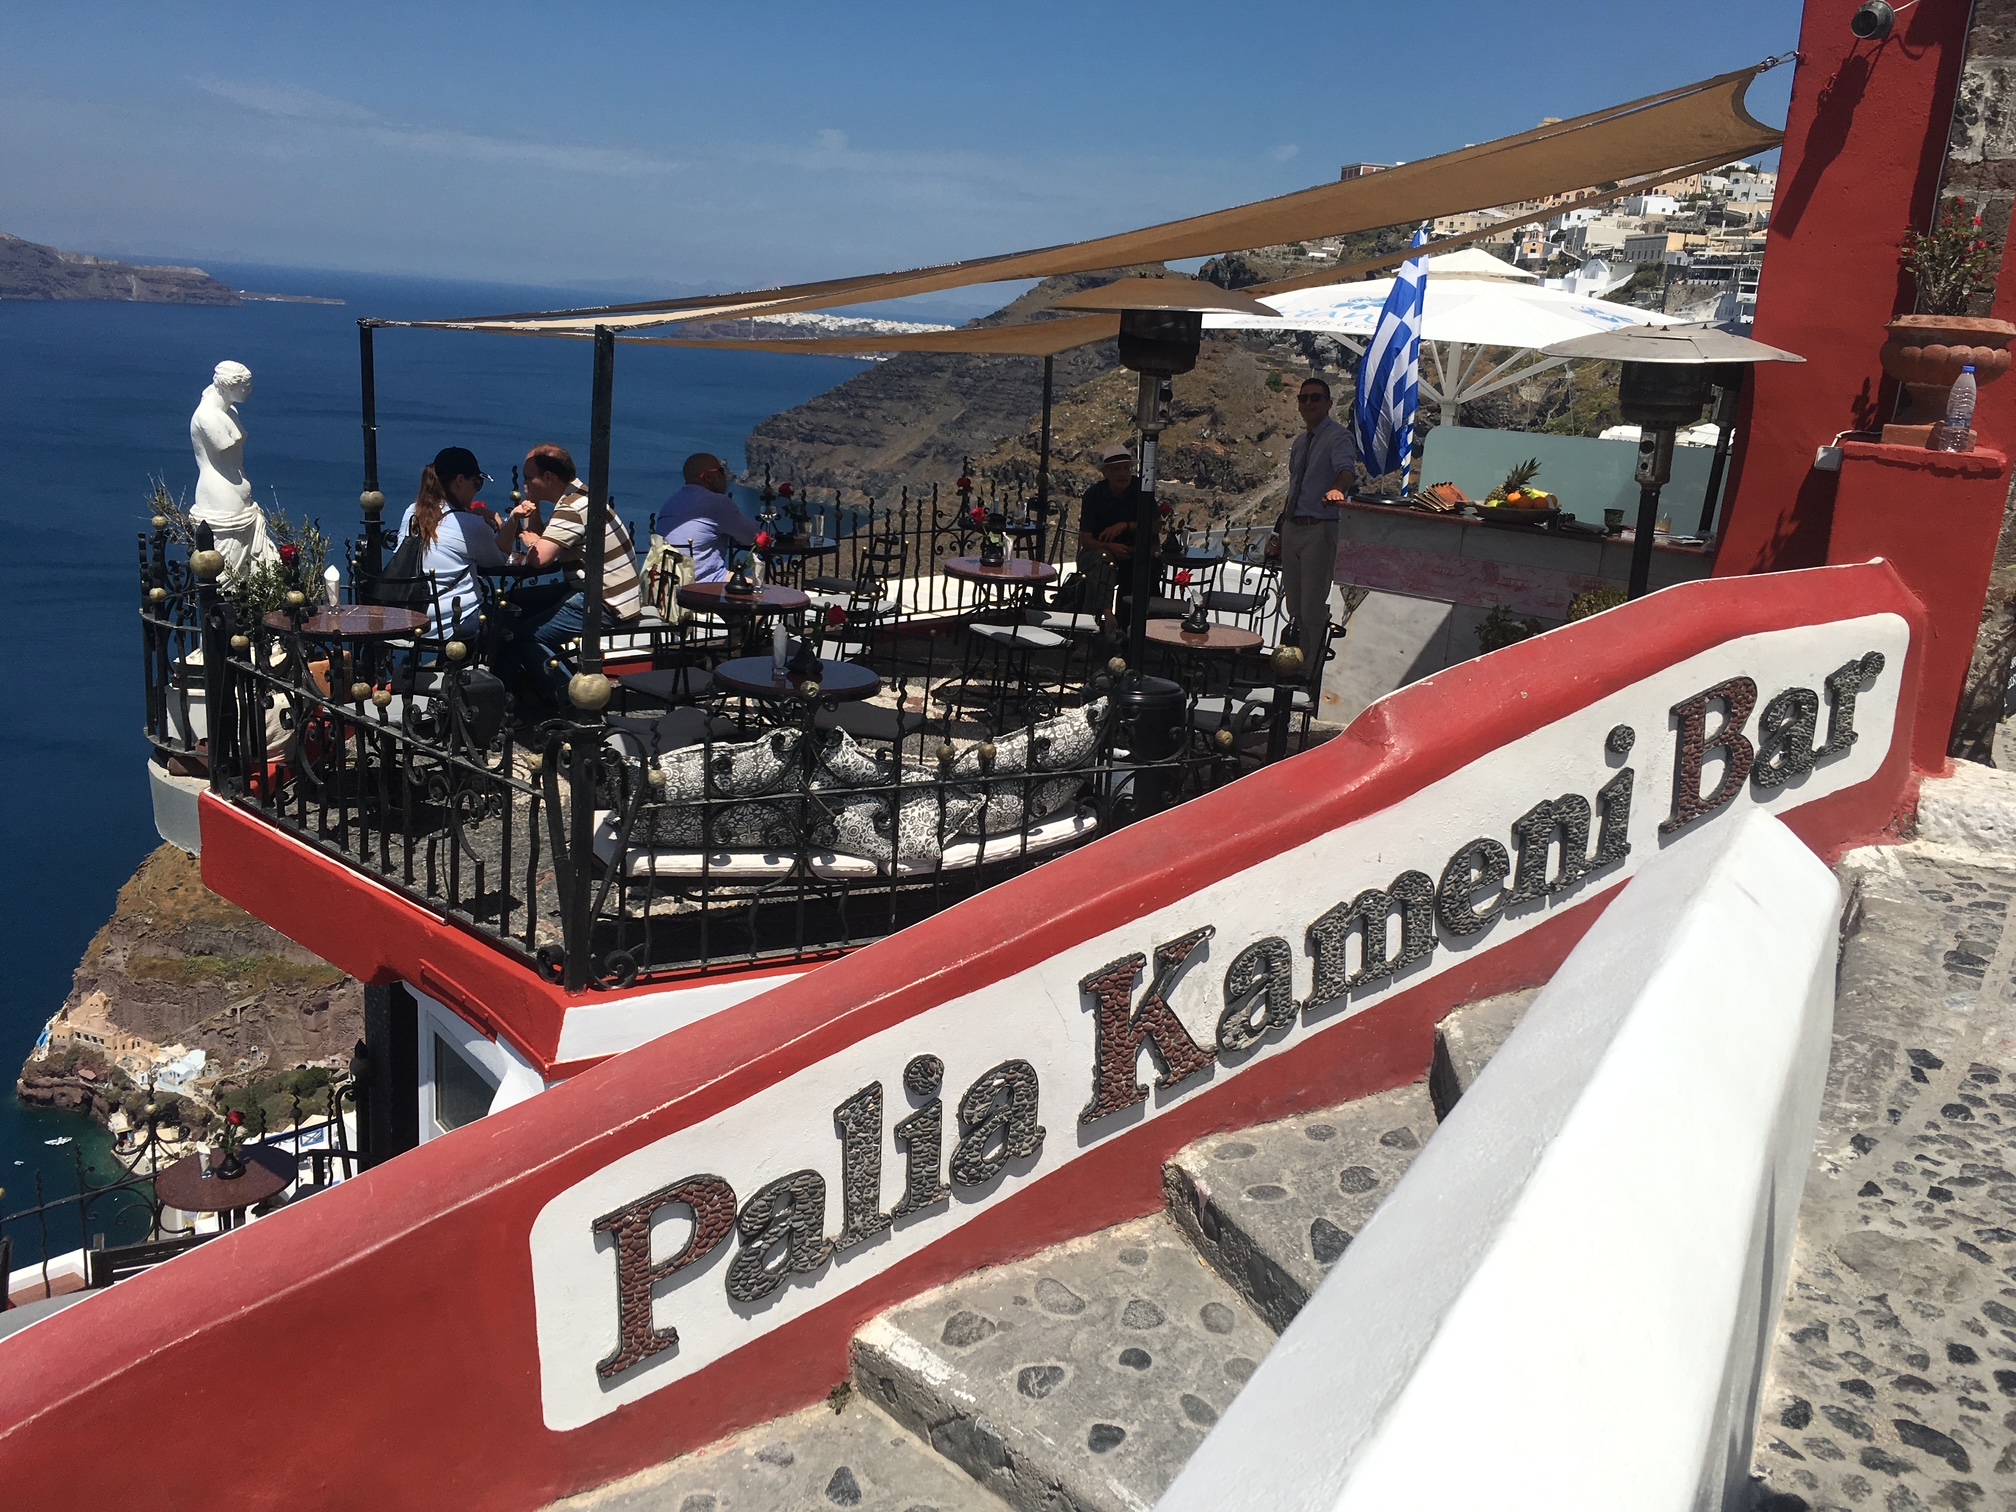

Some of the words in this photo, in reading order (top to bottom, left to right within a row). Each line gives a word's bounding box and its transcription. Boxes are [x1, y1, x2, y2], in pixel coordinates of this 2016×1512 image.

[591, 1053, 1047, 1380] Palia
[1078, 722, 1636, 1125] Kameni
[1657, 650, 1886, 835] Bar
